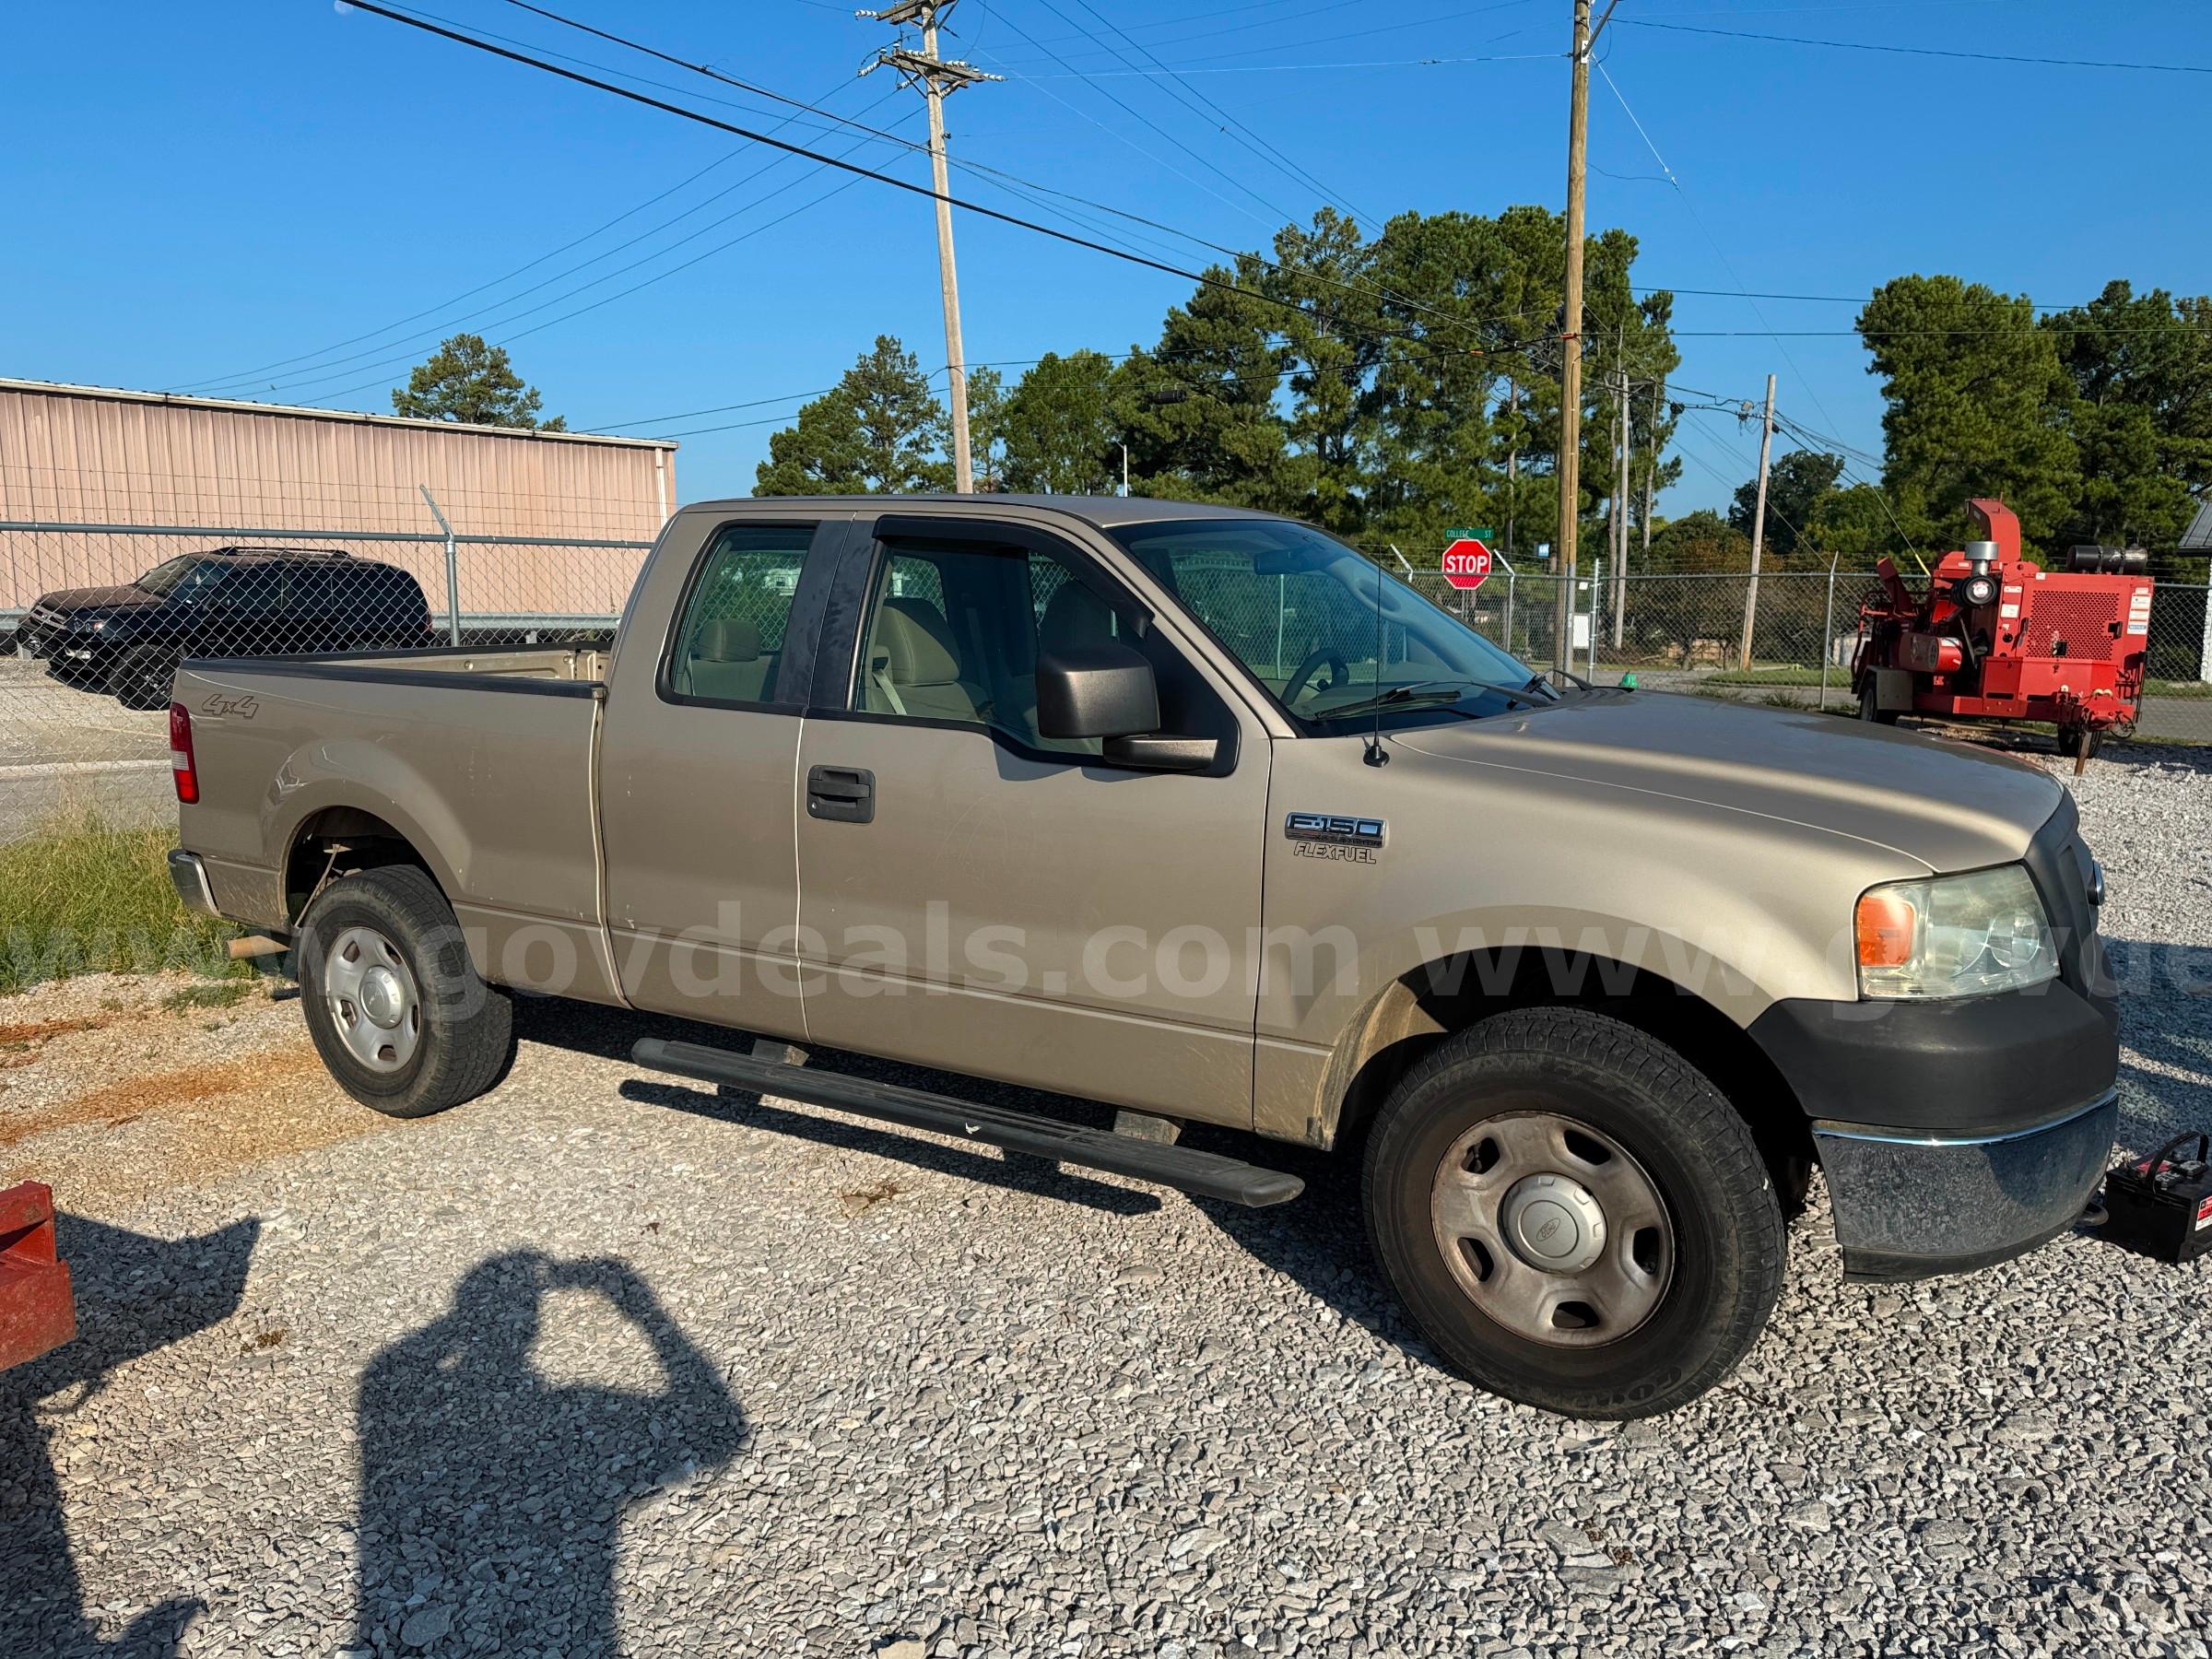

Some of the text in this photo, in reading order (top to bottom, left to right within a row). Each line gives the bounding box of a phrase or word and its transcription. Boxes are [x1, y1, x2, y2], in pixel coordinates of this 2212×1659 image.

[1446, 529, 1491, 538] COLLEGE ST
[1446, 555, 1488, 573] STOP
[202, 693, 259, 719] 4x4
[1294, 841, 1376, 865] FLEXFUEL
